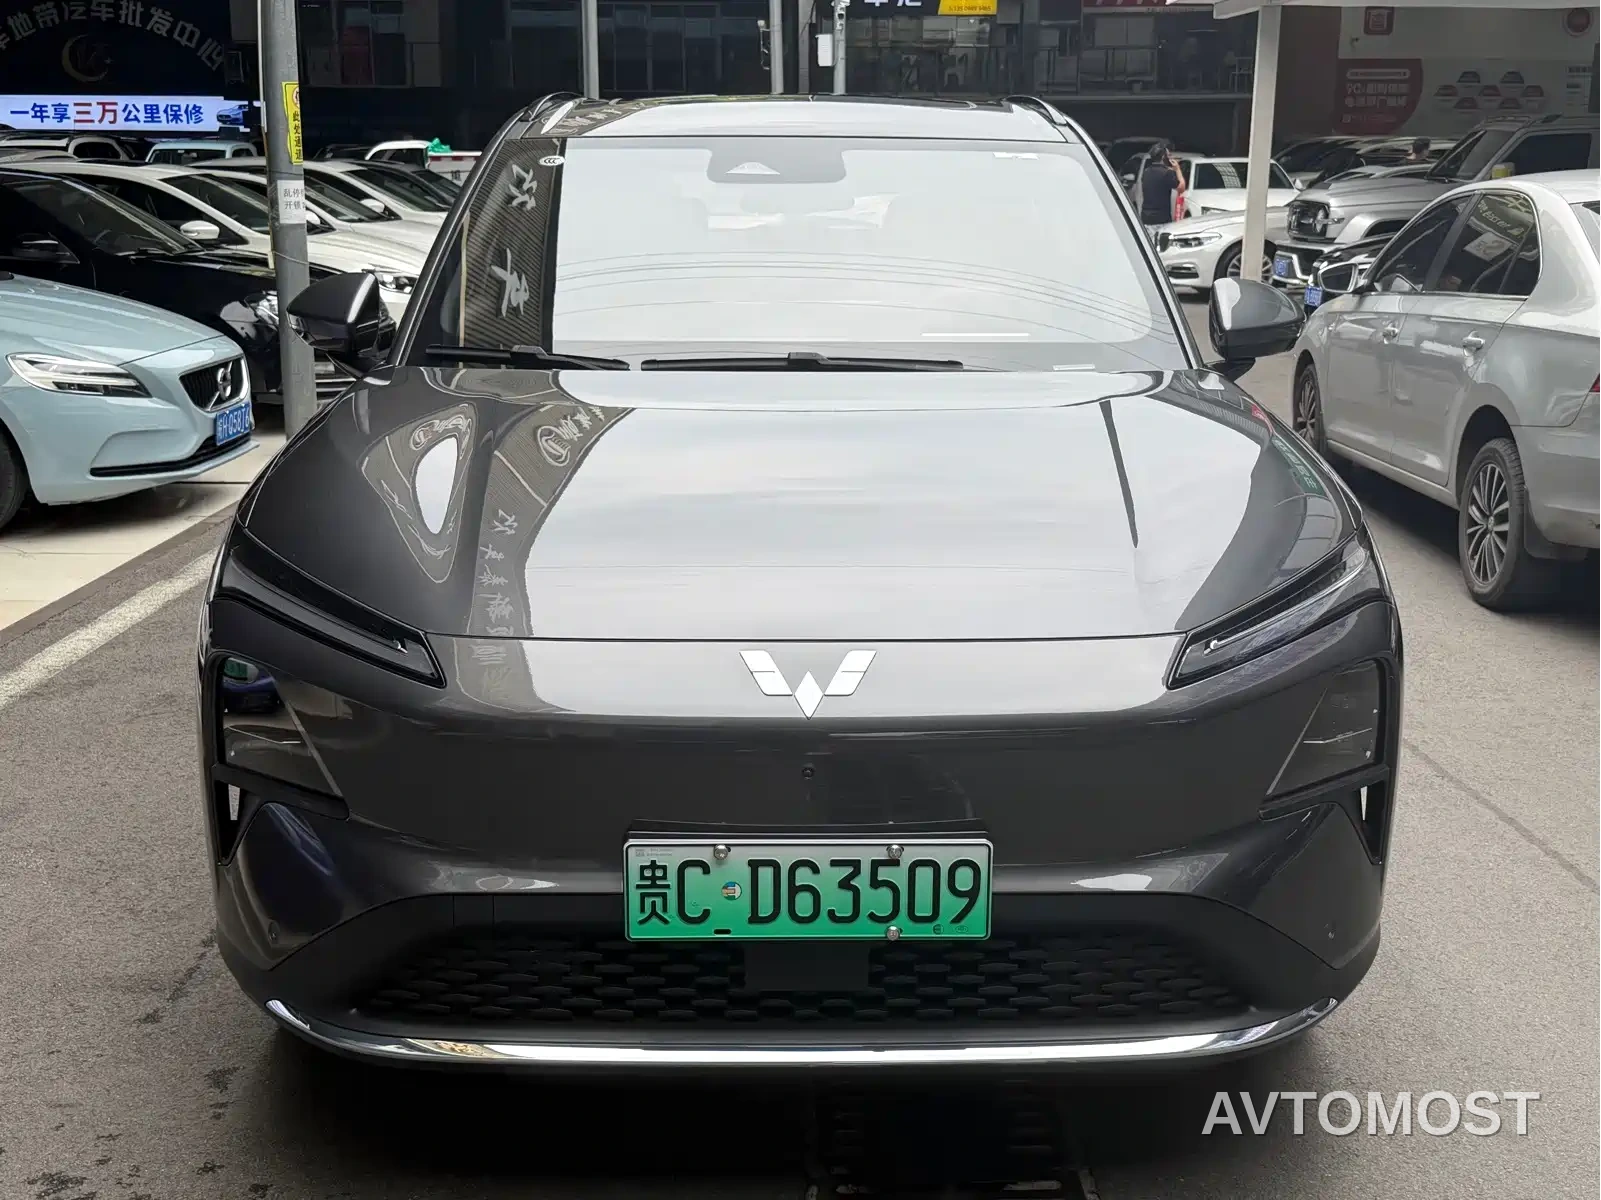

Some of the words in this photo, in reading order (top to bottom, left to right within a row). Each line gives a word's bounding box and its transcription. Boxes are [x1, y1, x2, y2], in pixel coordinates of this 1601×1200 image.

[10, 101, 204, 125] 一年享三万公里保修
